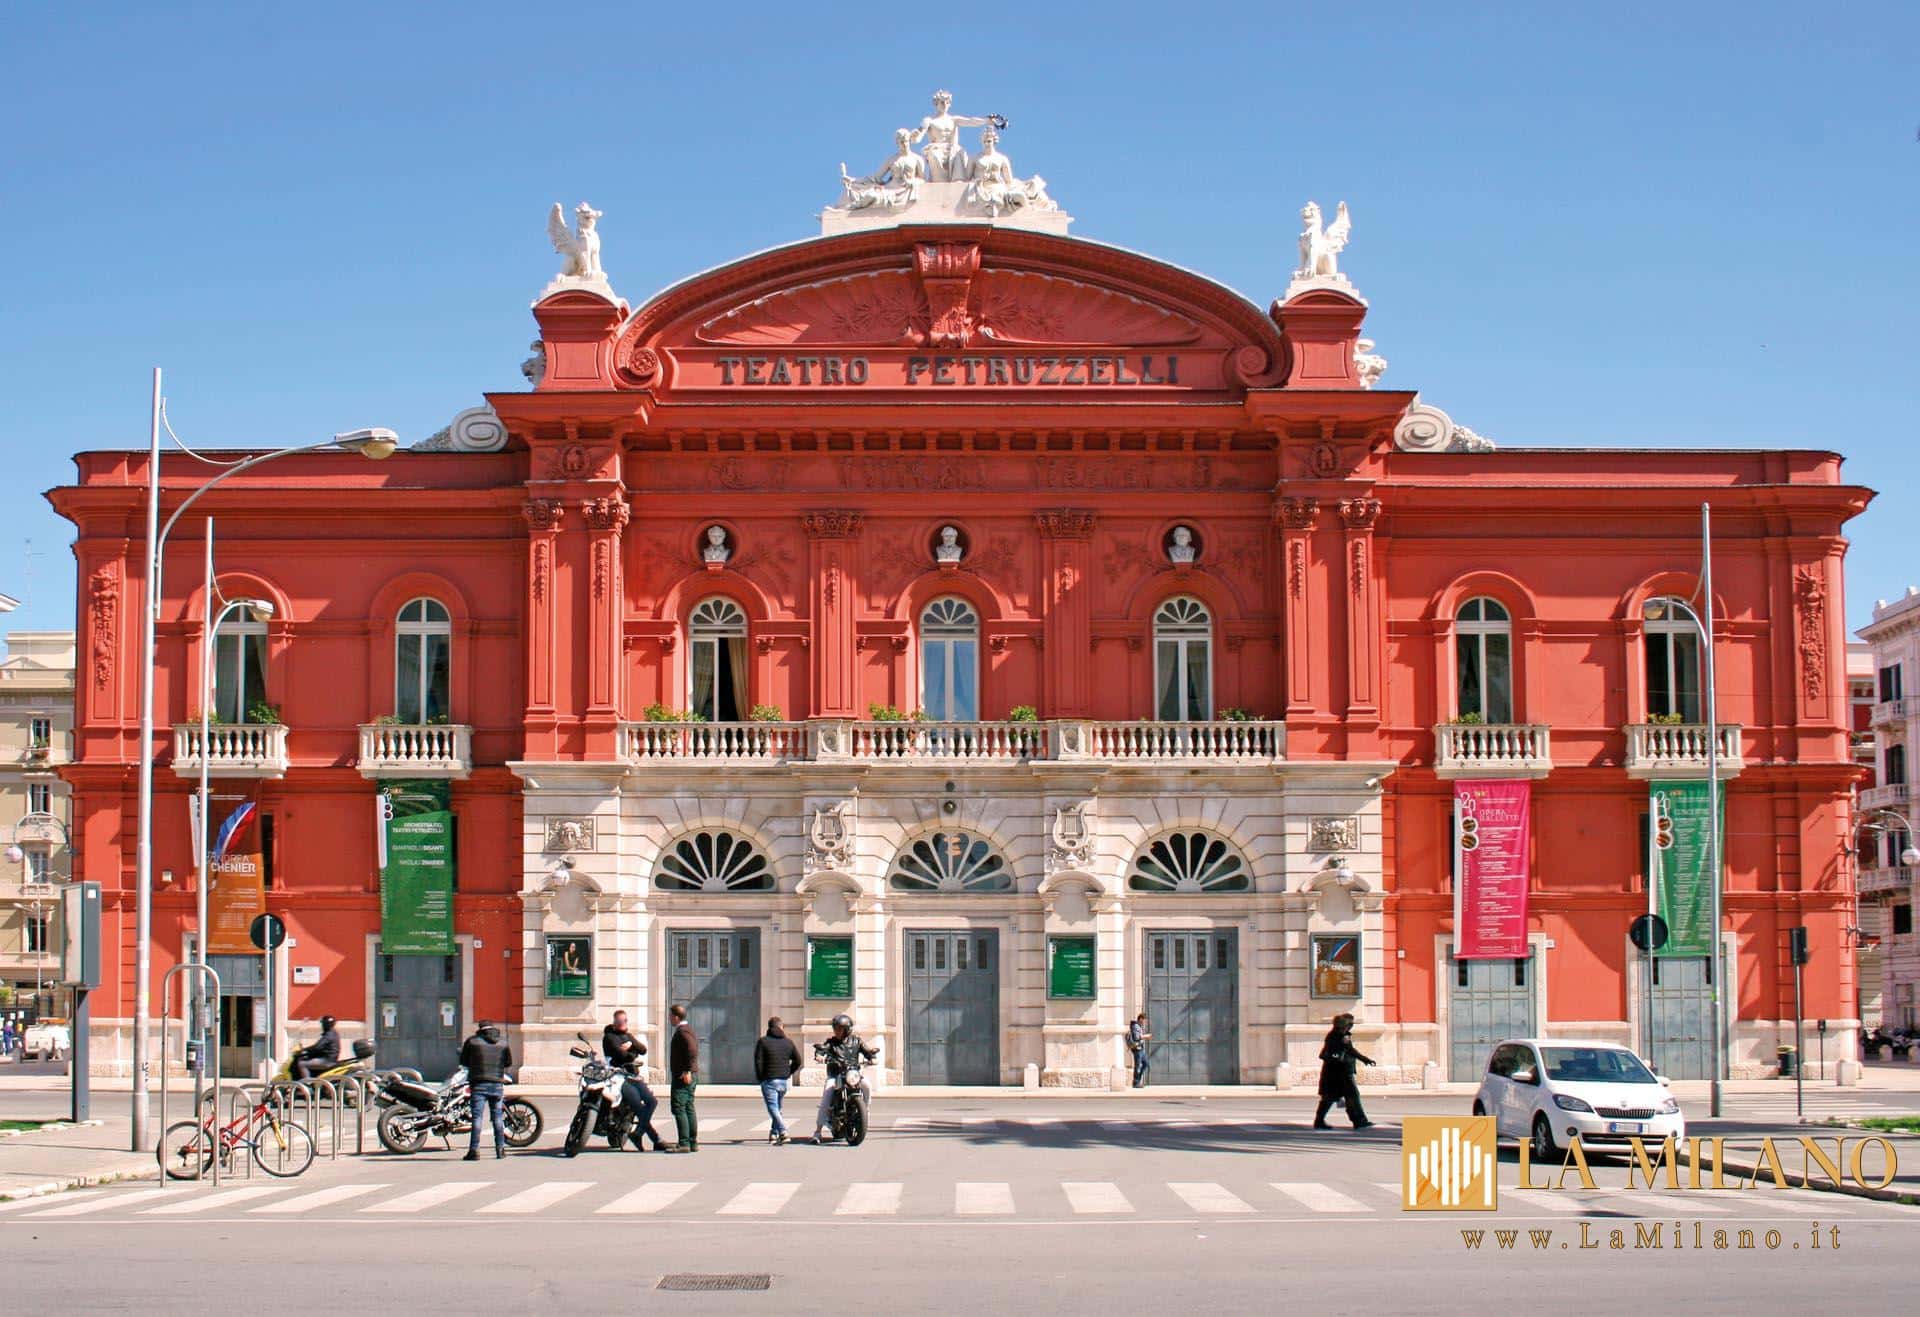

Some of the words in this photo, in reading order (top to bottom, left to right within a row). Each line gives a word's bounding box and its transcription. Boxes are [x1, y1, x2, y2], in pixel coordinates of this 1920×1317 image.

[718, 356, 871, 384] TEATRO
[907, 356, 1179, 384] PETRUZZELLI
[210, 863, 257, 873] CHENIER
